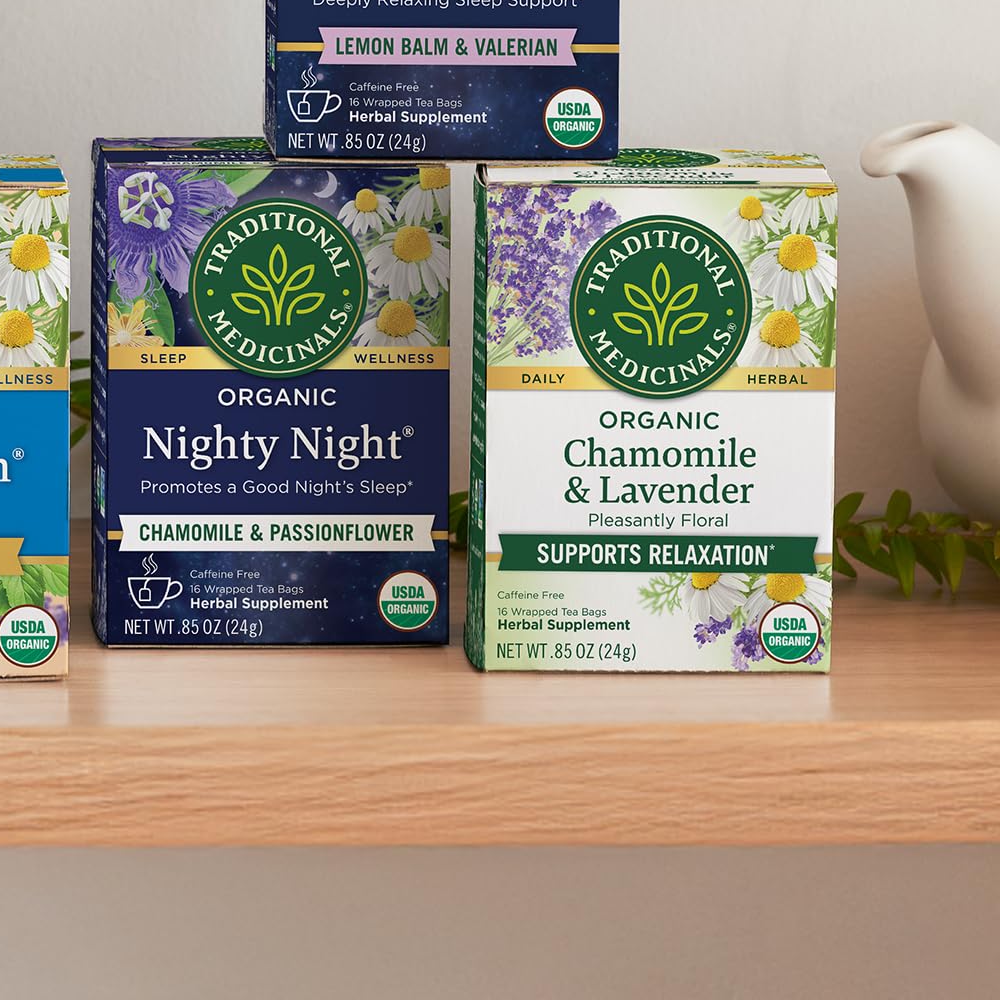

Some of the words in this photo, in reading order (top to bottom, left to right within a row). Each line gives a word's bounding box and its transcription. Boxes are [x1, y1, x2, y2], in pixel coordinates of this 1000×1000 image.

[336, 37, 394, 56] LEMON
[402, 38, 449, 56] BALM
[455, 38, 468, 56] &
[475, 38, 558, 56] VALERIAN
[350, 98, 359, 107] 16
[363, 98, 411, 109] Wrapped
[415, 98, 433, 108] Tea
[436, 98, 462, 109] Bags
[557, 102, 591, 116] USDA
[350, 111, 396, 123] Herbal
[401, 111, 487, 125] Supplement
[553, 120, 595, 132] ORGANIC
[204, 212, 351, 277] TRADITIONAL
[586, 230, 735, 297] TRADITIONAL
[140, 353, 187, 364] SLEEP
[354, 353, 434, 364] WELLNESS
[522, 373, 565, 384] DAILY
[748, 374, 808, 385] HERBAL
[218, 388, 337, 407] ORGANIC
[599, 411, 720, 430] ORGANIC
[143, 424, 279, 471] Nighty
[564, 437, 757, 468] Chamomile
[141, 480, 222, 494] Promotes
[228, 484, 236, 494] a
[242, 480, 289, 494] Good
[564, 476, 590, 504] &
[600, 473, 754, 504] Lavender
[589, 513, 675, 529] Pleasantly
[682, 514, 729, 527] Floral
[139, 524, 243, 542] CHAMOMILE
[250, 524, 263, 542] &
[270, 524, 414, 542] PASSIONFLOWER
[537, 543, 642, 565] SUPPORTS
[190, 570, 233, 579] Caffeine
[237, 570, 260, 579] Free
[190, 584, 200, 594] 16
[204, 584, 253, 596] Wrapped
[257, 585, 274, 594] Tea
[278, 585, 304, 596] Bags
[391, 586, 425, 599] USDA
[190, 597, 237, 609] Herbal
[242, 598, 328, 611] Supplement
[387, 604, 429, 615] ORGANIC
[497, 607, 508, 616] 16
[511, 607, 558, 618] Wrapped
[561, 607, 579, 616] Tea
[582, 607, 607, 618] Bags
[10, 620, 45, 635] USDA
[125, 619, 150, 635] NET
[154, 619, 175, 635] WT
[177, 619, 199, 635] .85
[203, 619, 221, 635] OZ
[225, 619, 263, 639] (24g)
[497, 619, 543, 631] Herbal
[547, 619, 630, 633] Supplement
[6, 638, 49, 650] ORGANIC
[497, 643, 522, 659] NET
[526, 643, 547, 659] WT
[550, 643, 572, 659] .85
[576, 643, 594, 660] OZ
[599, 643, 636, 663] (24g)
